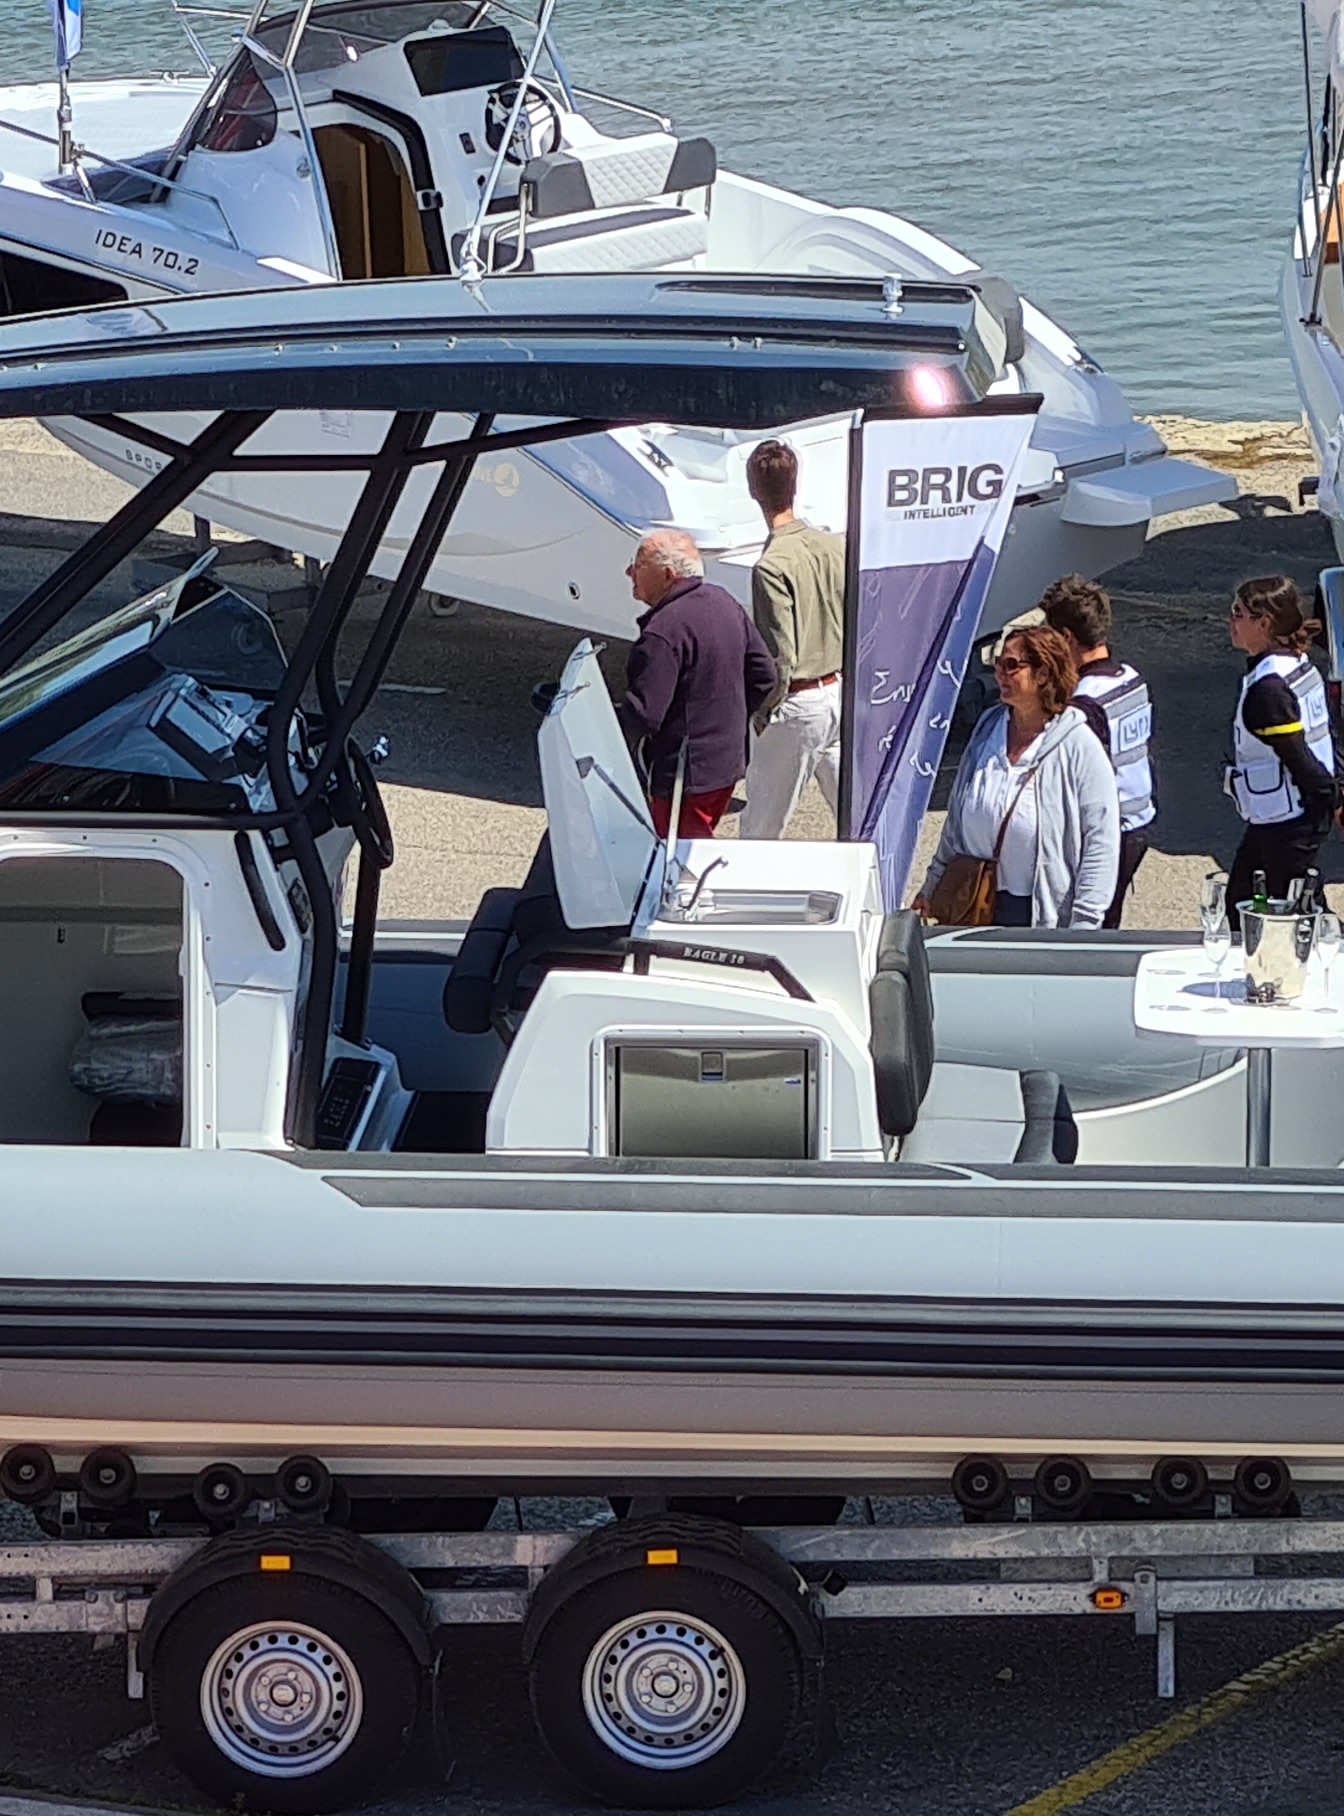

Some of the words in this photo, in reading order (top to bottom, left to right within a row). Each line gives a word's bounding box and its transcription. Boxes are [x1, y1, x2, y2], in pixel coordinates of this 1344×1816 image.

[95, 229, 142, 259] IDEA
[152, 247, 199, 275] 70.2
[886, 463, 1004, 508] BRIG
[683, 947, 728, 964] EAGLE
